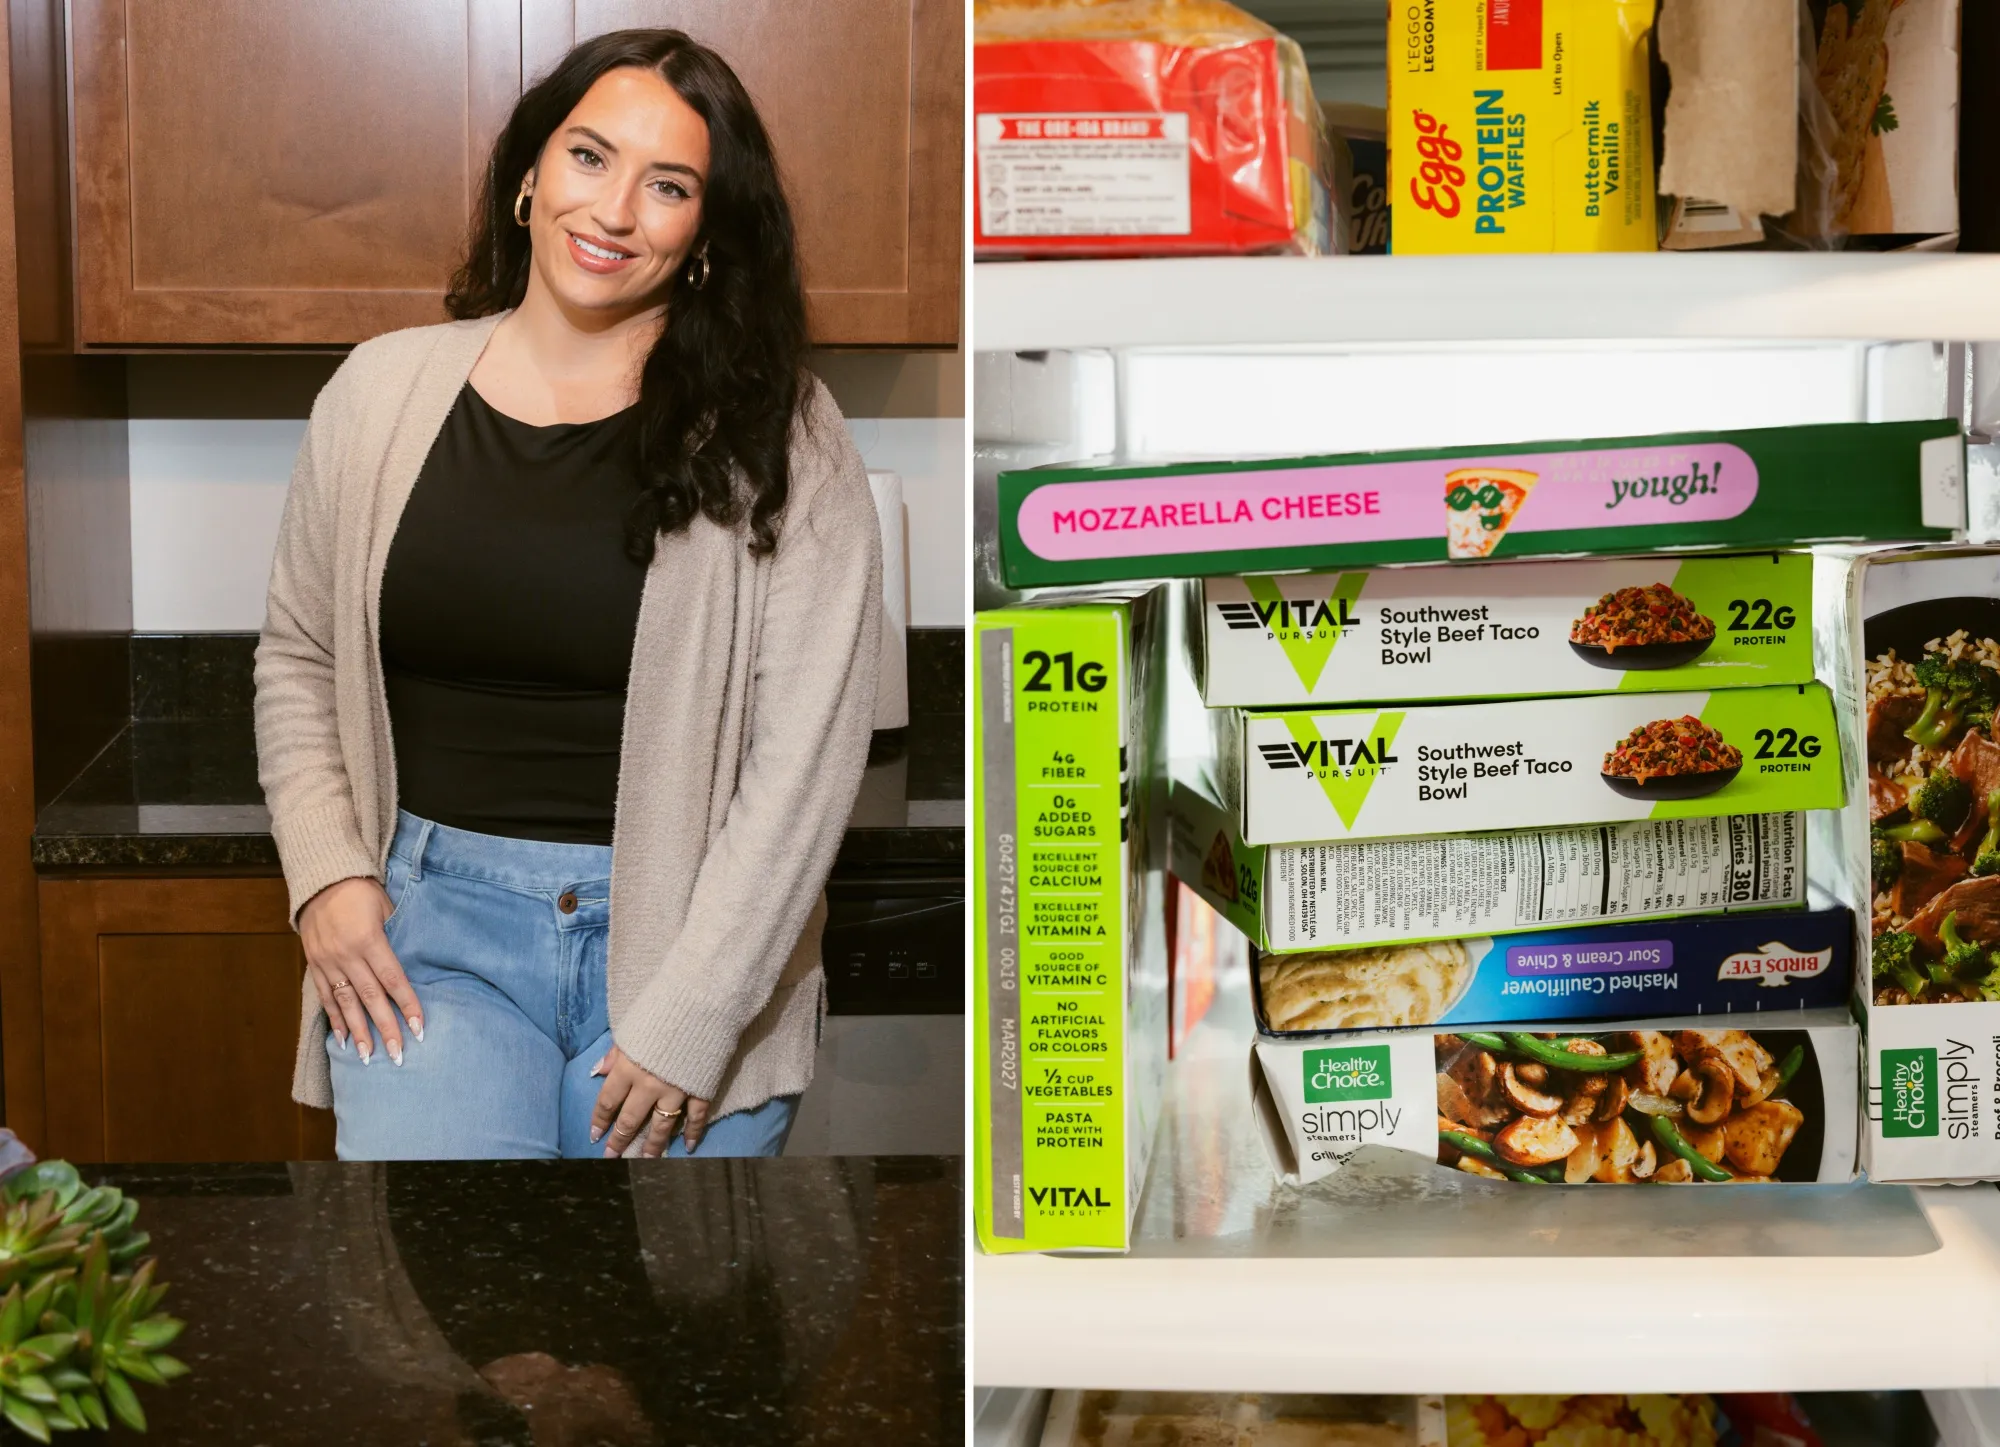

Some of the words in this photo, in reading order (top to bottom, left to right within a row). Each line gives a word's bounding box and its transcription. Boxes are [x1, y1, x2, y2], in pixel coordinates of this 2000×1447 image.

[1408, 6, 1420, 72] L'EGGO
[1553, 32, 1563, 60] Open
[1555, 64, 1562, 74] to
[1553, 77, 1562, 95] Lift
[1410, 109, 1465, 218] Eggo
[1473, 90, 1505, 233] PROTEIN
[1508, 113, 1525, 209] WAFFLES
[1582, 100, 1600, 216] Buttermilk
[1601, 122, 1619, 195] Vanilla
[1605, 461, 1722, 509] yough!
[1053, 499, 1254, 534] MOZZARELLA
[1261, 490, 1381, 521] CHEESE
[1250, 598, 1360, 628] VITAL
[1380, 604, 1489, 624] Southwest
[1727, 599, 1796, 631] 22G
[1267, 630, 1349, 640] PURSUIT
[1380, 627, 1431, 648] Style
[1437, 624, 1484, 643] Beef
[1489, 624, 1540, 641] Taco
[1733, 635, 1786, 646] PROTEIN
[1381, 647, 1431, 665] Bowl
[1022, 650, 1108, 693] 21G
[1028, 701, 1098, 712] PROTEIN
[1290, 737, 1398, 767] VITAL
[1417, 741, 1524, 762] Southwest
[1754, 728, 1822, 760] 22G
[1052, 750, 1075, 764] 4G
[1042, 767, 1086, 778] FIBER
[1307, 768, 1387, 779] PURSUIT
[1417, 764, 1468, 785] Style
[1473, 760, 1520, 779] Beef
[1524, 759, 1573, 776] Taco
[1760, 763, 1811, 774] PROTEIN
[1418, 783, 1467, 801] Bowl
[1053, 795, 1076, 810] 0G
[1038, 812, 1092, 823] ADDED
[1710, 816, 1718, 832] Total
[1034, 825, 1096, 837] SUGARS
[1609, 826, 1618, 850] Protein
[1654, 822, 1662, 838] Total
[1665, 821, 1673, 845] Sodium
[1677, 820, 1686, 857] Cholesterol
[1772, 816, 1780, 845] serving
[1783, 811, 1794, 863] Nutrition
[1643, 830, 1652, 852] Dietary
[1700, 825, 1708, 854] Saturated
[1732, 815, 1747, 865] Calories
[1763, 841, 1771, 854] size
[1033, 853, 1098, 862] EXCELLENT
[1498, 837, 1506, 875] CAULIFLOWER
[1507, 836, 1515, 874] INGREDIENTS:
[1632, 847, 1641, 868] Sugars
[1645, 854, 1653, 869] Fiber
[1655, 839, 1664, 882] Carbohydrate
[1667, 847, 1675, 869] 930mg
[1772, 848, 1780, 859] per
[1033, 864, 1079, 873] SOURCE
[1083, 864, 1098, 873] OF
[1678, 858, 1687, 876] 50mg
[1763, 860, 1771, 877] pizza
[1029, 875, 1102, 887] CALCIUM
[1733, 869, 1751, 901] 380
[1773, 862, 1781, 898] container
[1783, 867, 1794, 898] Facts
[1302, 889, 1307, 898] OH
[1310, 891, 1315, 900] BY
[1034, 903, 1098, 911] EXCELLENT
[1034, 914, 1080, 923] SOURCE
[1084, 914, 1099, 923] OF
[1026, 925, 1094, 937] VITAMIN
[1095, 925, 1107, 936] A
[1049, 952, 1084, 961] GOOD
[1518, 953, 1558, 969] Chive
[1564, 952, 1573, 967] &
[1576, 950, 1623, 965] Cream
[1627, 949, 1661, 964] Sour
[1766, 957, 1818, 973] BIRDS
[1035, 963, 1081, 972] SOURCE
[1085, 963, 1100, 972] OF
[1731, 960, 1761, 974] EYE
[1027, 974, 1094, 986] VITAMIN
[1096, 974, 1107, 985] C
[1500, 976, 1605, 997] Cauliflower
[1609, 973, 1678, 991] Mashed
[1057, 1001, 1078, 1012] NO
[1030, 1015, 1105, 1025] ARTIFICIAL
[1038, 1028, 1098, 1039] FLAVORS
[1001, 1017, 1017, 1090] MAR2027
[1029, 1042, 1048, 1053] OR
[1052, 1042, 1108, 1052] COLORS
[1319, 1057, 1377, 1074] Healthy
[1067, 1075, 1094, 1084] CUP
[1311, 1071, 1380, 1089] Choice
[1025, 1086, 1113, 1097] VEGETABLES
[1892, 1063, 1911, 1121] Healthy
[1907, 1060, 1926, 1129] Choice
[1046, 1113, 1093, 1123] PASTA
[1971, 1084, 1979, 1137] steamers
[1037, 1126, 1069, 1135] MADE
[1072, 1126, 1102, 1134] WITH
[1302, 1101, 1402, 1143] simply
[1036, 1137, 1103, 1148] PROTEIN
[1307, 1134, 1356, 1142] steamers
[1029, 1187, 1111, 1208] VITAL
[1039, 1209, 1102, 1217] PURSUIT
